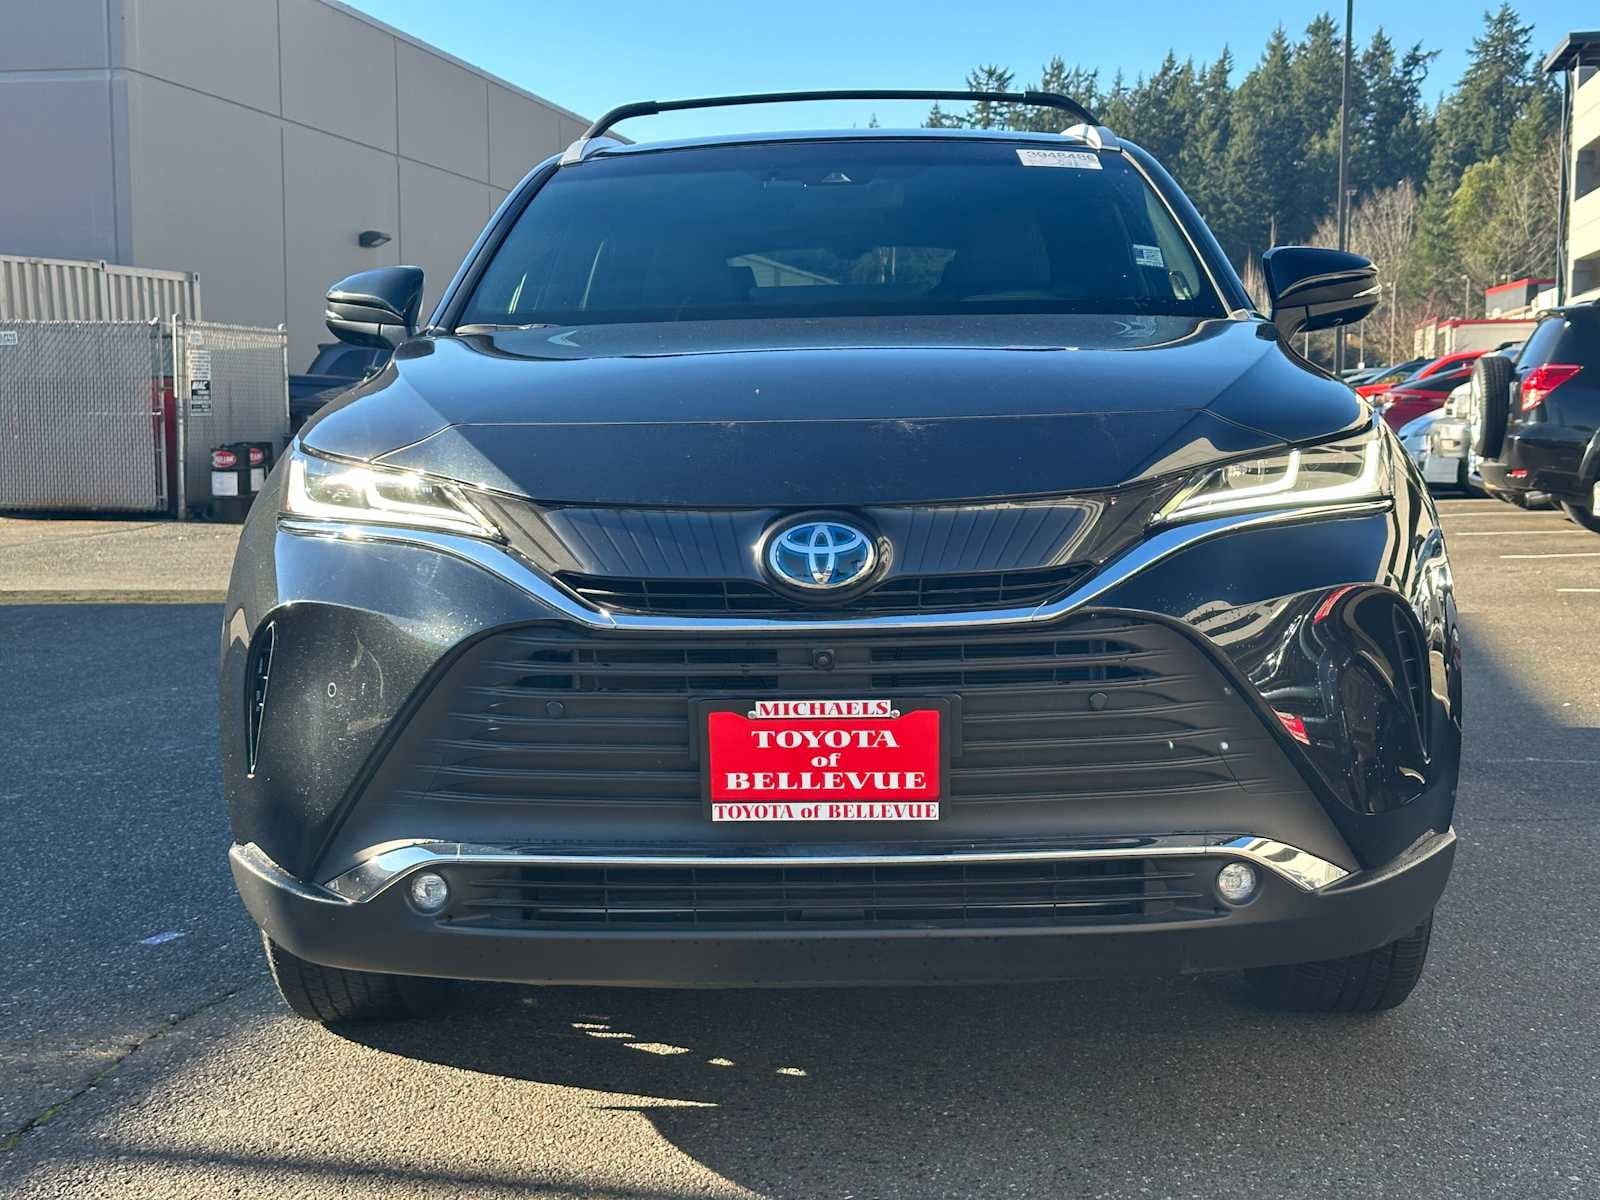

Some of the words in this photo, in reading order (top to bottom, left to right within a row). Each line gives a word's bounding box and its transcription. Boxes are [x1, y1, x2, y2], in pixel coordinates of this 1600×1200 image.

[759, 701, 889, 716] MICHAELS
[751, 730, 900, 748] TOYOTA
[810, 753, 842, 768] of
[725, 772, 926, 790] BELLEVUE
[714, 804, 794, 819] TOYOTA
[800, 804, 823, 818] of
[829, 804, 937, 819] BELLEVUE
